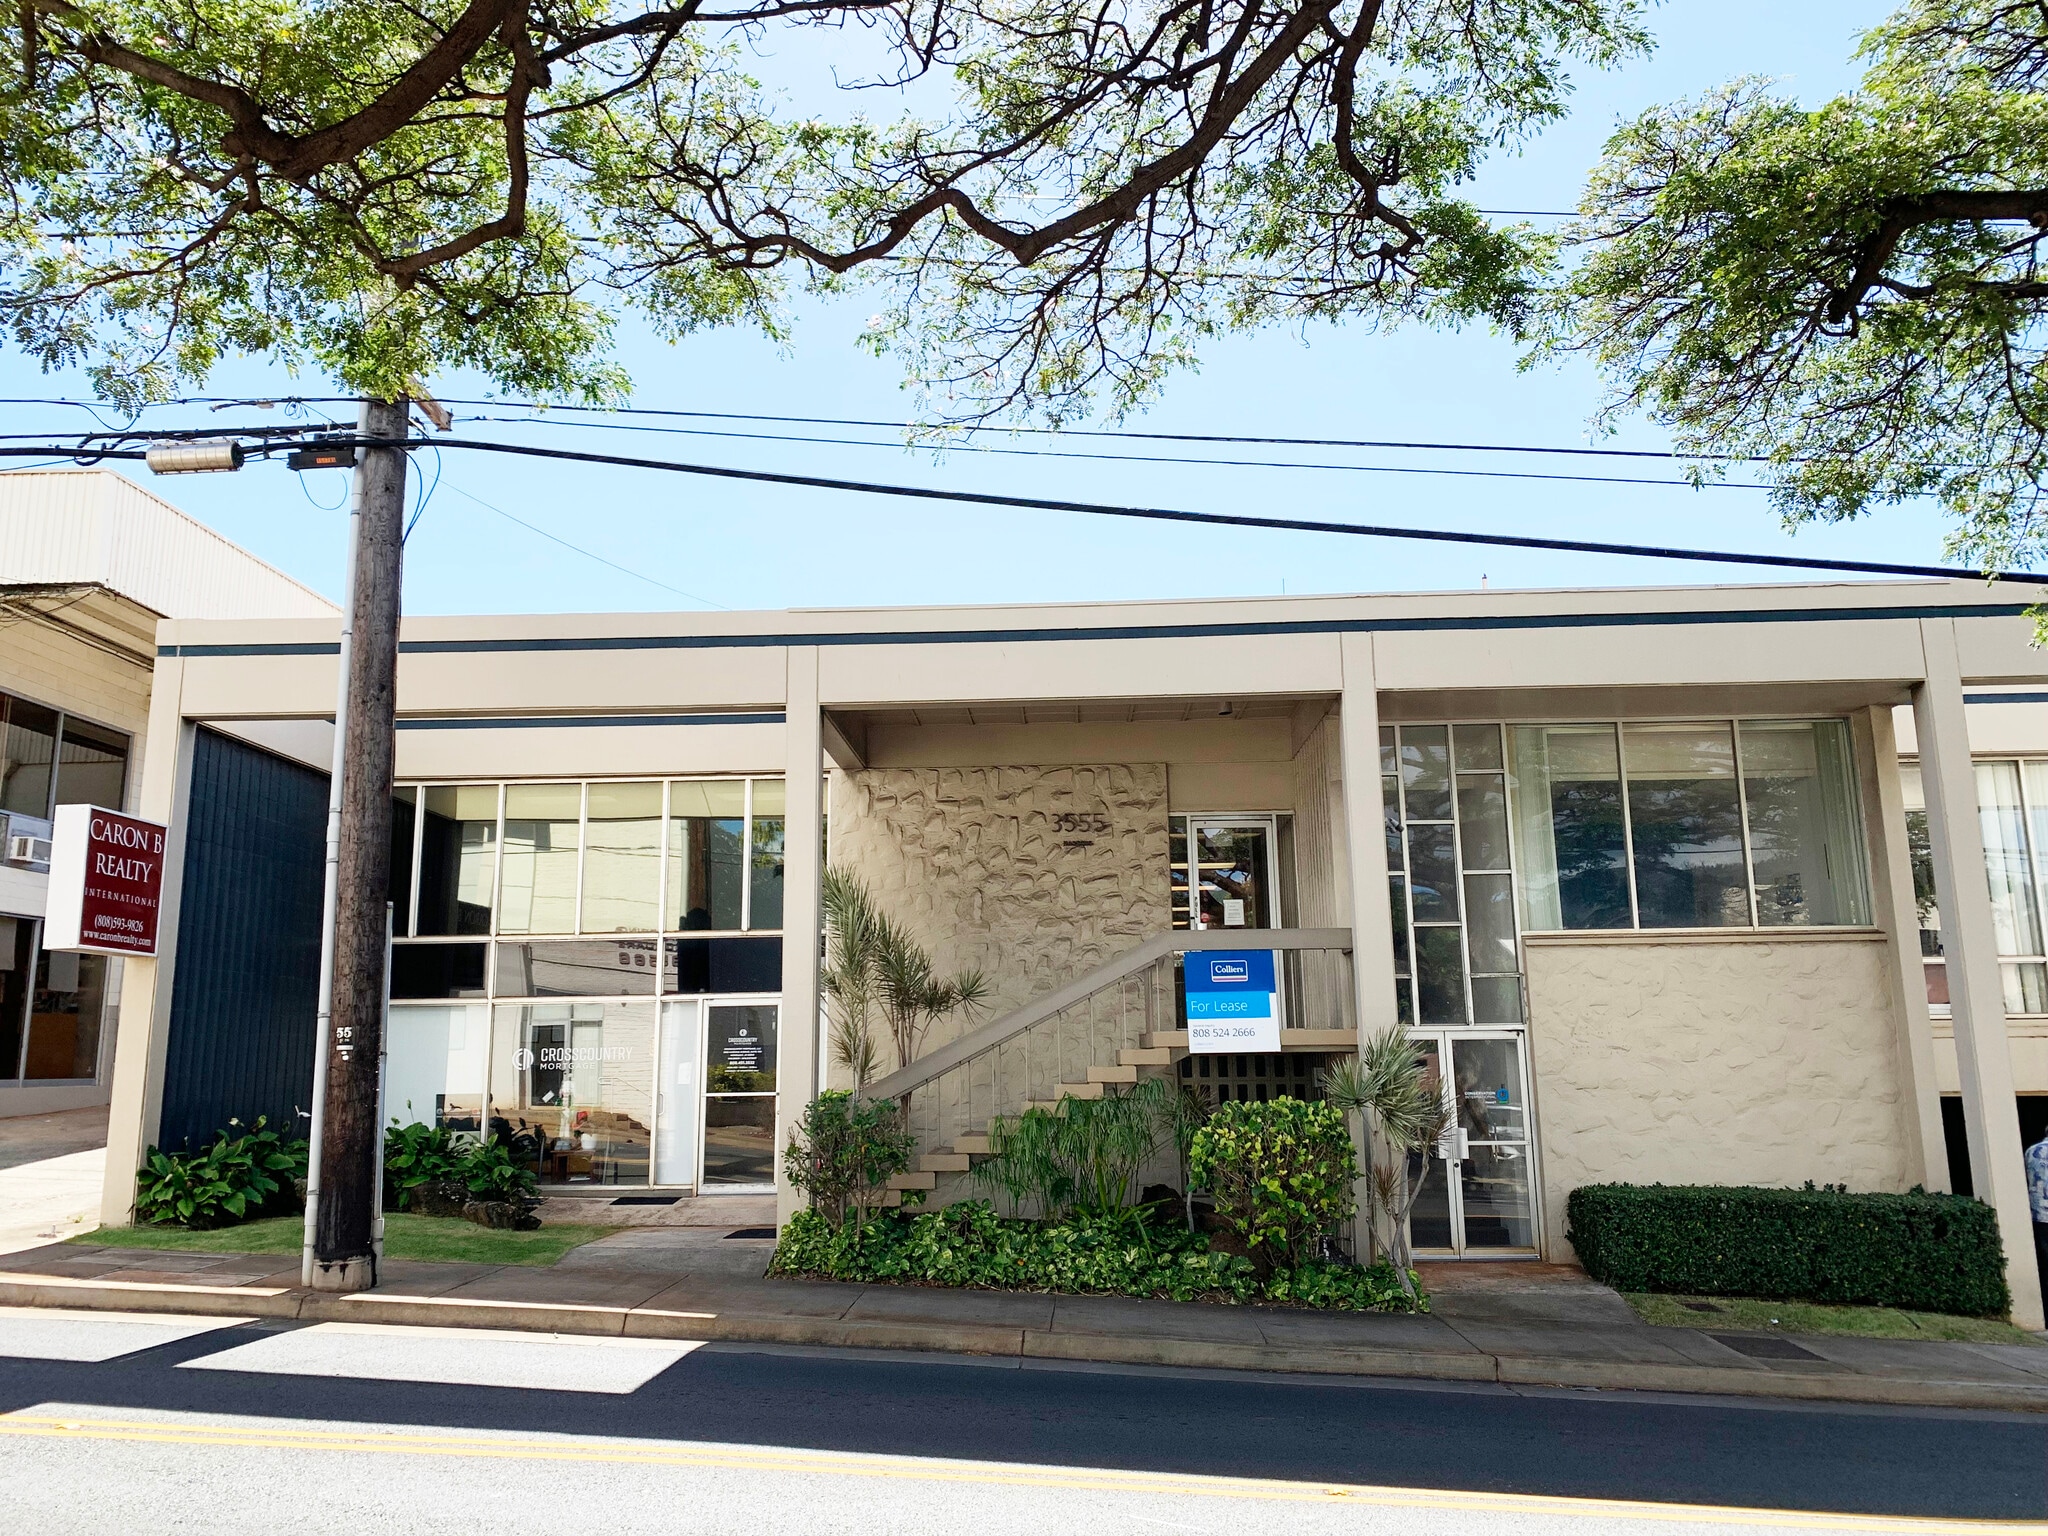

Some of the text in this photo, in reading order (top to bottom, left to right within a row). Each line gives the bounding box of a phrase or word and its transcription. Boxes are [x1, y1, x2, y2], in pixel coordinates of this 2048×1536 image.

[1051, 812, 1105, 833] 3555
[90, 818, 162, 854] CARON B
[95, 852, 153, 883] REALTY
[84, 886, 157, 908] INTERNATIONAL
[94, 914, 144, 933] (808)593-9826
[83, 929, 152, 947] www.caronbrealty.com
[1215, 965, 1244, 974] Colliers
[1191, 1000, 1248, 1012] For Lease
[336, 1026, 353, 1039] 55
[1192, 1027, 1256, 1038] 808 524 2666
[540, 1047, 633, 1062] CROSSCOUNTRY
